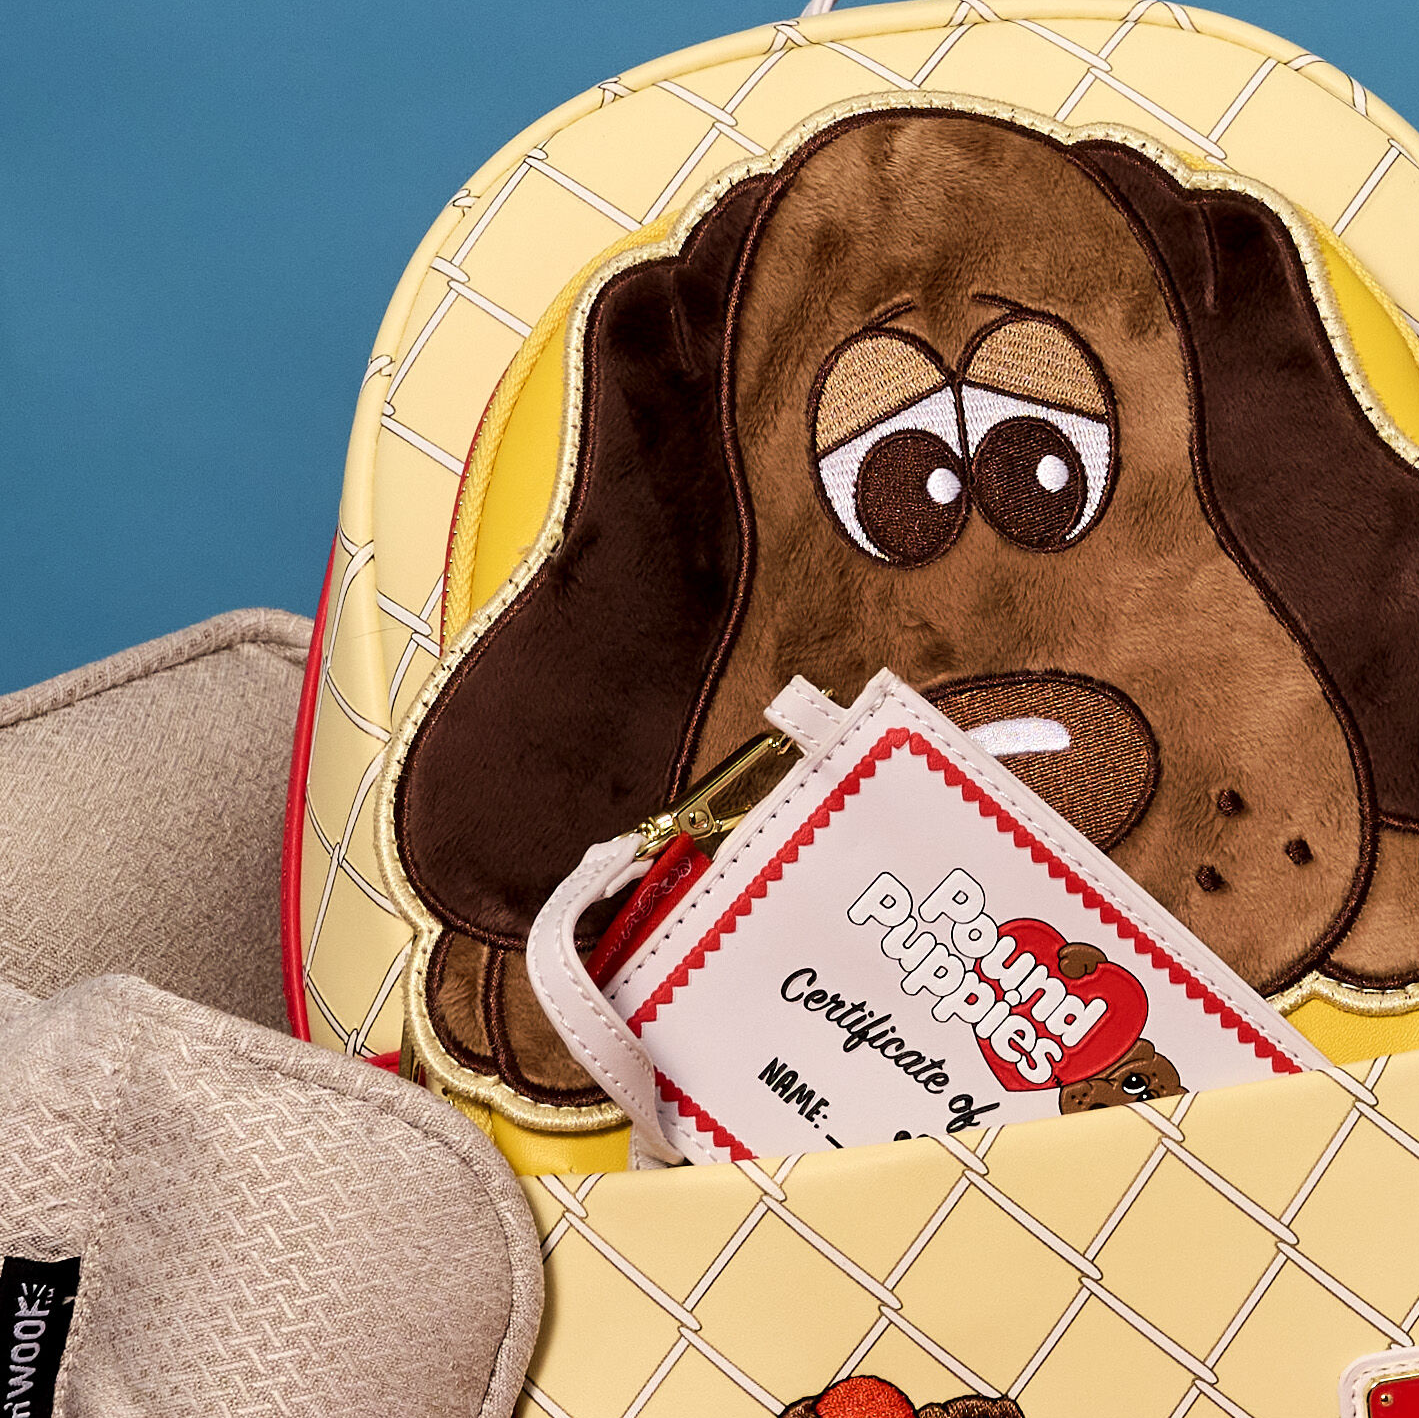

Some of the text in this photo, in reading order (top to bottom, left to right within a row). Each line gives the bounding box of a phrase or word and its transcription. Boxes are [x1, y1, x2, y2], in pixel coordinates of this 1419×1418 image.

[847, 871, 1064, 1084] Puppies
[918, 867, 1107, 1049] Pound
[757, 1056, 830, 1129] NAME:
[780, 967, 1001, 1133] Certificate of
